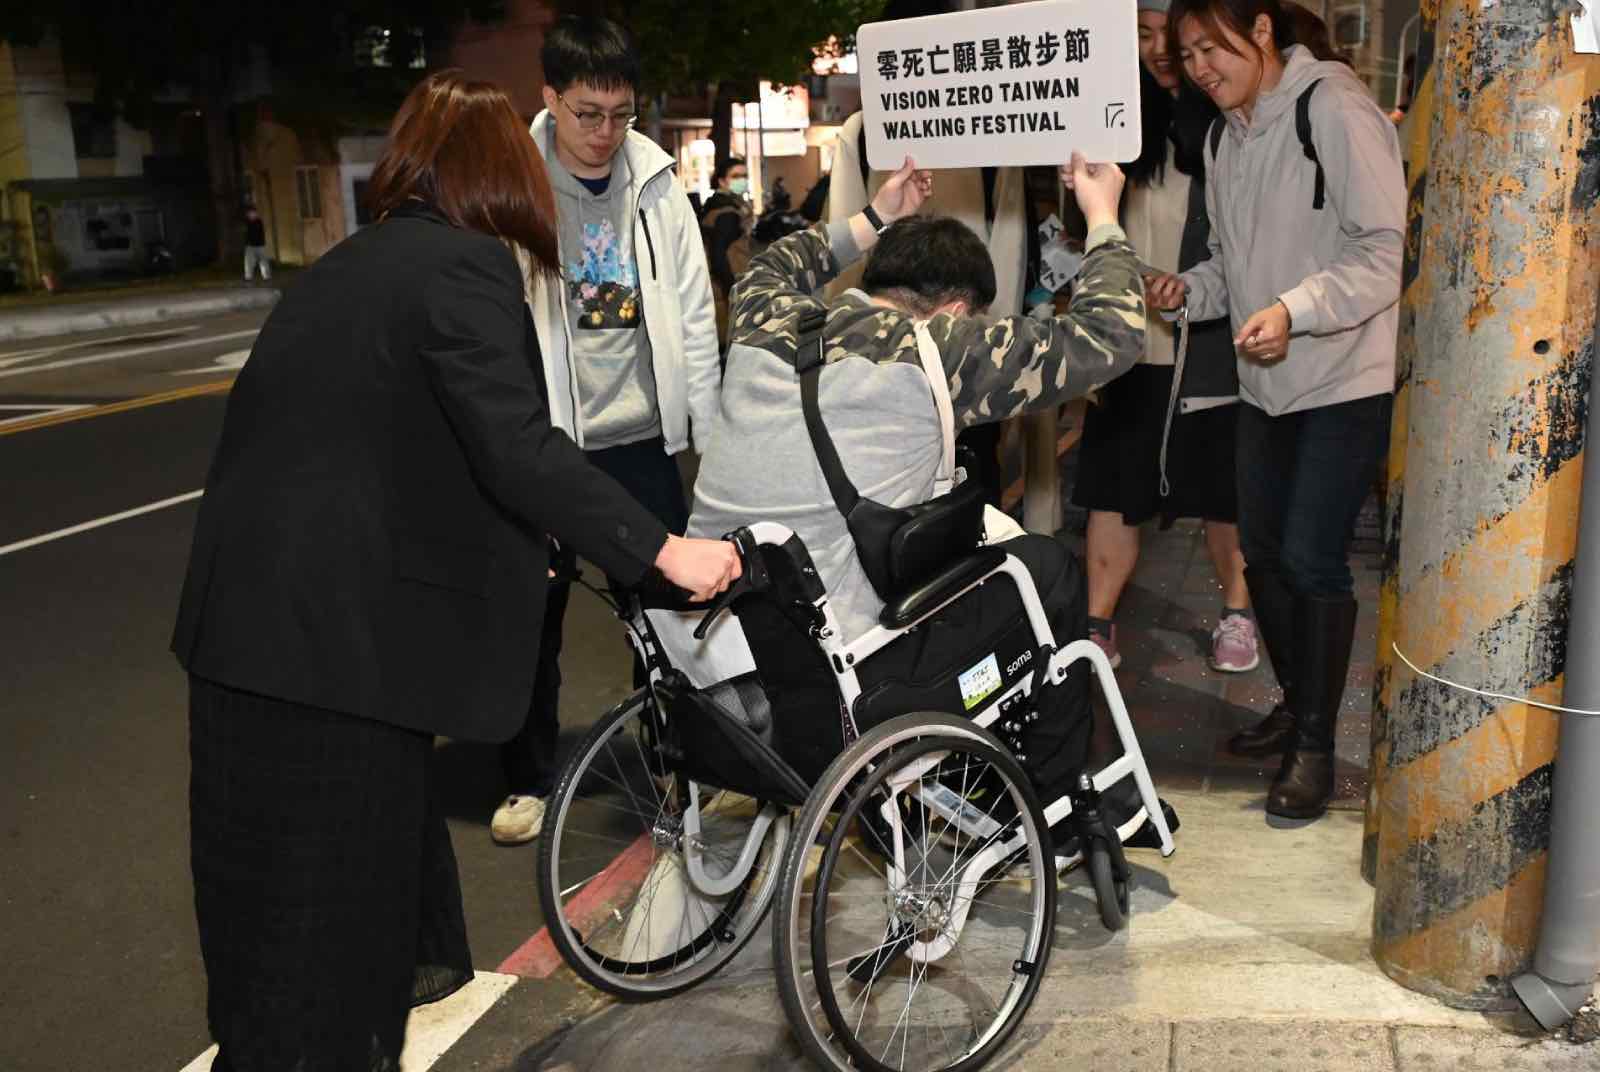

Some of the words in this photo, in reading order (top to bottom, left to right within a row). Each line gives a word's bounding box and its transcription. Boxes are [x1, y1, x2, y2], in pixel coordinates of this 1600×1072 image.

[877, 28, 1090, 81] 零死亡願景散步節
[880, 89, 940, 111] VISION
[945, 84, 993, 106] ZERO
[999, 77, 1080, 103] TAIWAN
[883, 117, 965, 140] WALKING
[971, 111, 1066, 136] FESTIVAL
[1007, 650, 1032, 676] soma
